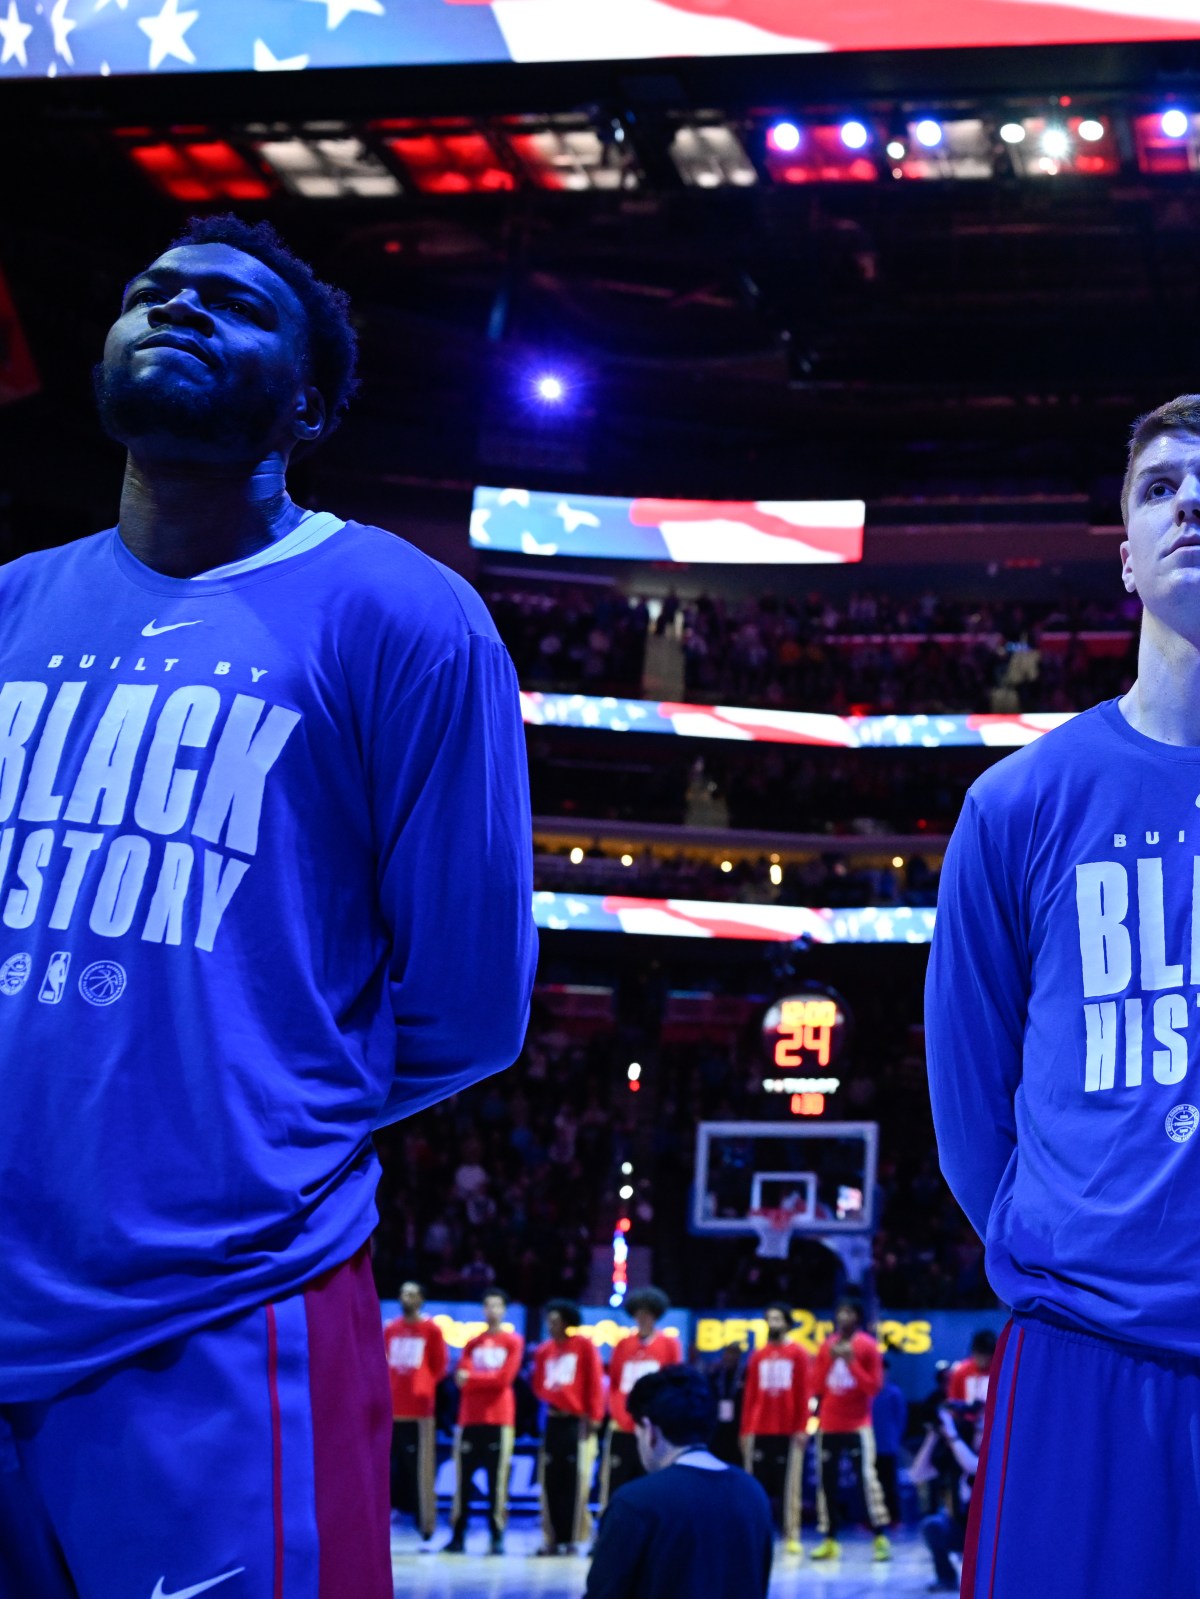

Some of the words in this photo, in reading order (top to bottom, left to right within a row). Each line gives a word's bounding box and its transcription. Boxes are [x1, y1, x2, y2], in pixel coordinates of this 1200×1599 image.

[47, 654, 180, 672] BUILT
[213, 661, 269, 683] BY
[0, 680, 302, 856] BLACK
[0, 827, 251, 953] STORY
[774, 1023, 832, 1067] 24
